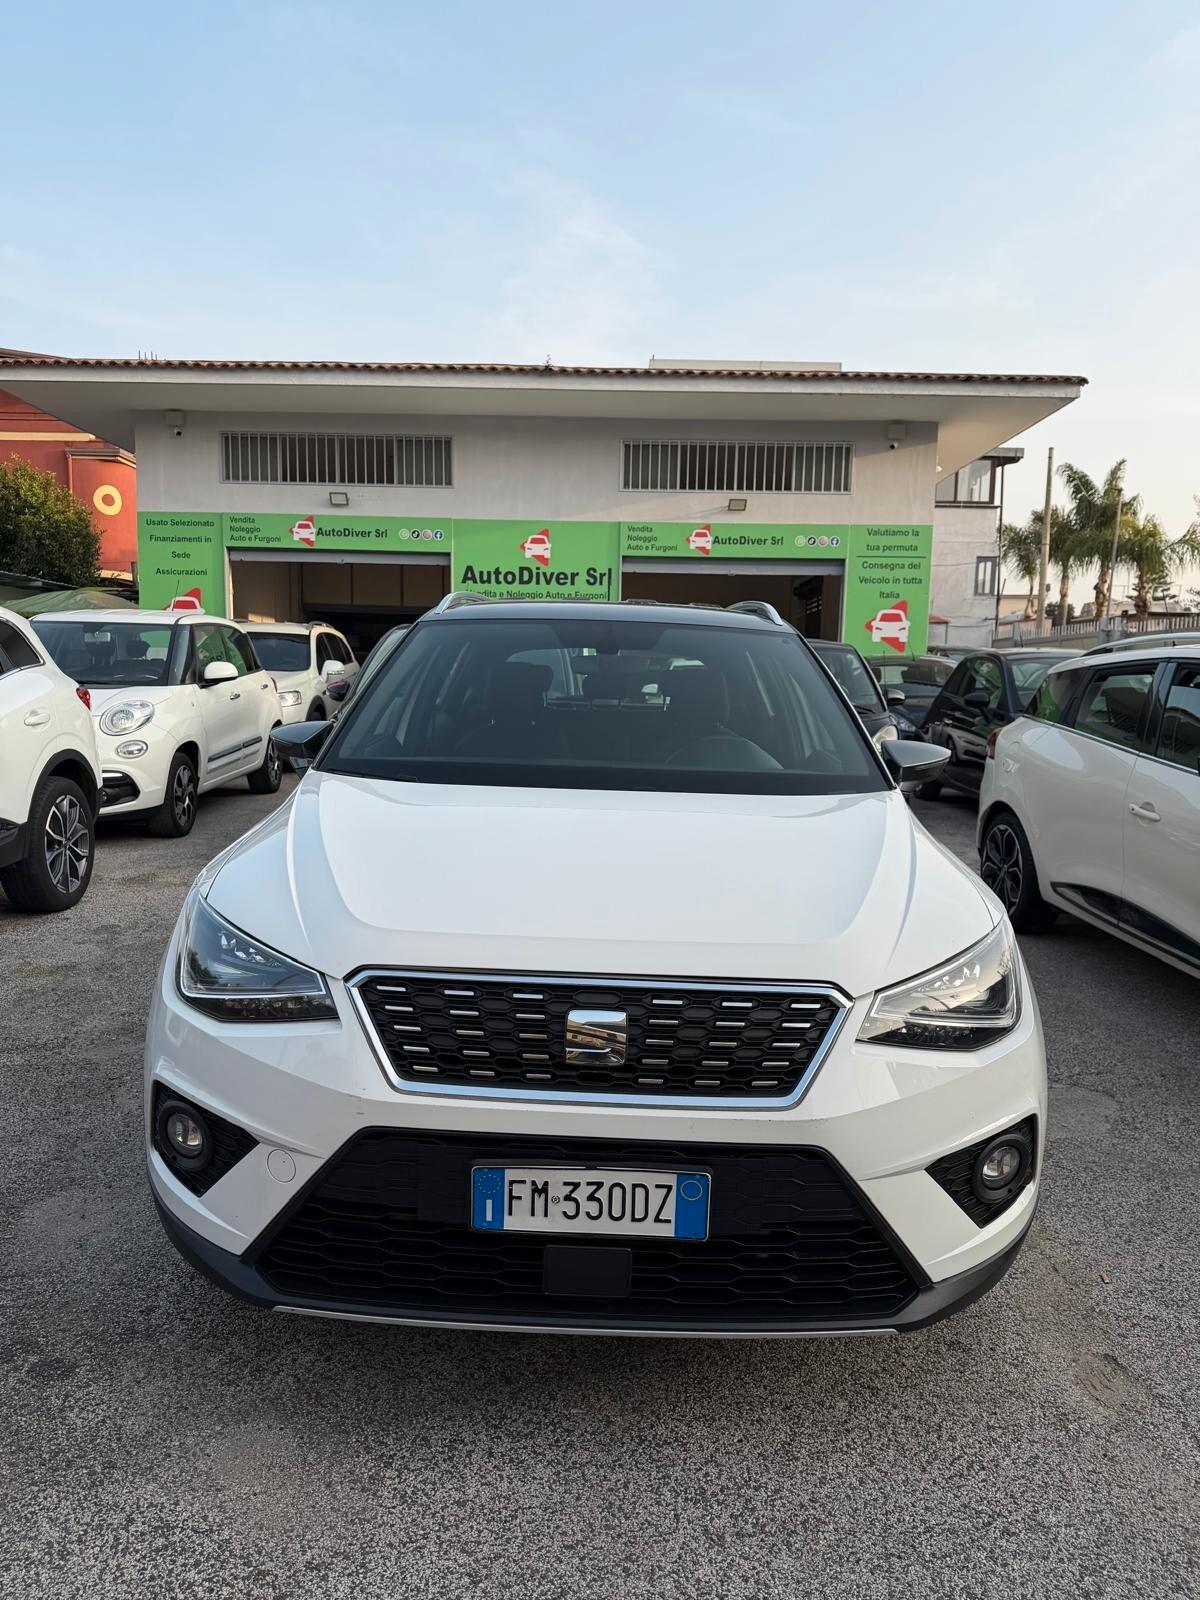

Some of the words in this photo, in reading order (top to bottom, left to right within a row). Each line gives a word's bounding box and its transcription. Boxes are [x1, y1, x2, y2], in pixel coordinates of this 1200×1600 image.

[146, 518, 168, 527] Usato
[170, 518, 215, 527] Selezionato
[229, 516, 256, 524] Vendita
[229, 525, 261, 534] Noleggio
[316, 527, 372, 538] AutoDiver
[374, 528, 388, 539] Srl
[627, 525, 653, 533] Vendita
[866, 528, 910, 537] Valutiamo
[911, 529, 920, 537] la
[149, 534, 203, 543] Finanziamenti
[204, 535, 212, 543] in
[254, 535, 282, 544] Furgoni
[627, 535, 658, 543] Noleggio
[713, 535, 768, 546] AutoDiver
[770, 536, 784, 546] Srl
[651, 544, 678, 553] Furgoni
[881, 544, 918, 553] permuta
[171, 551, 191, 559] Sede
[861, 561, 905, 571] Consegna
[907, 561, 921, 570] del
[155, 568, 208, 576] Assicurazioni
[461, 565, 580, 586] AutoDiver
[585, 567, 612, 587] Srl
[858, 576, 890, 584] Veicolo
[892, 576, 901, 584] in
[506, 590, 544, 599] Noleggio
[545, 591, 565, 599] Auto
[574, 591, 607, 600] Furgoni
[879, 591, 900, 599] Italia
